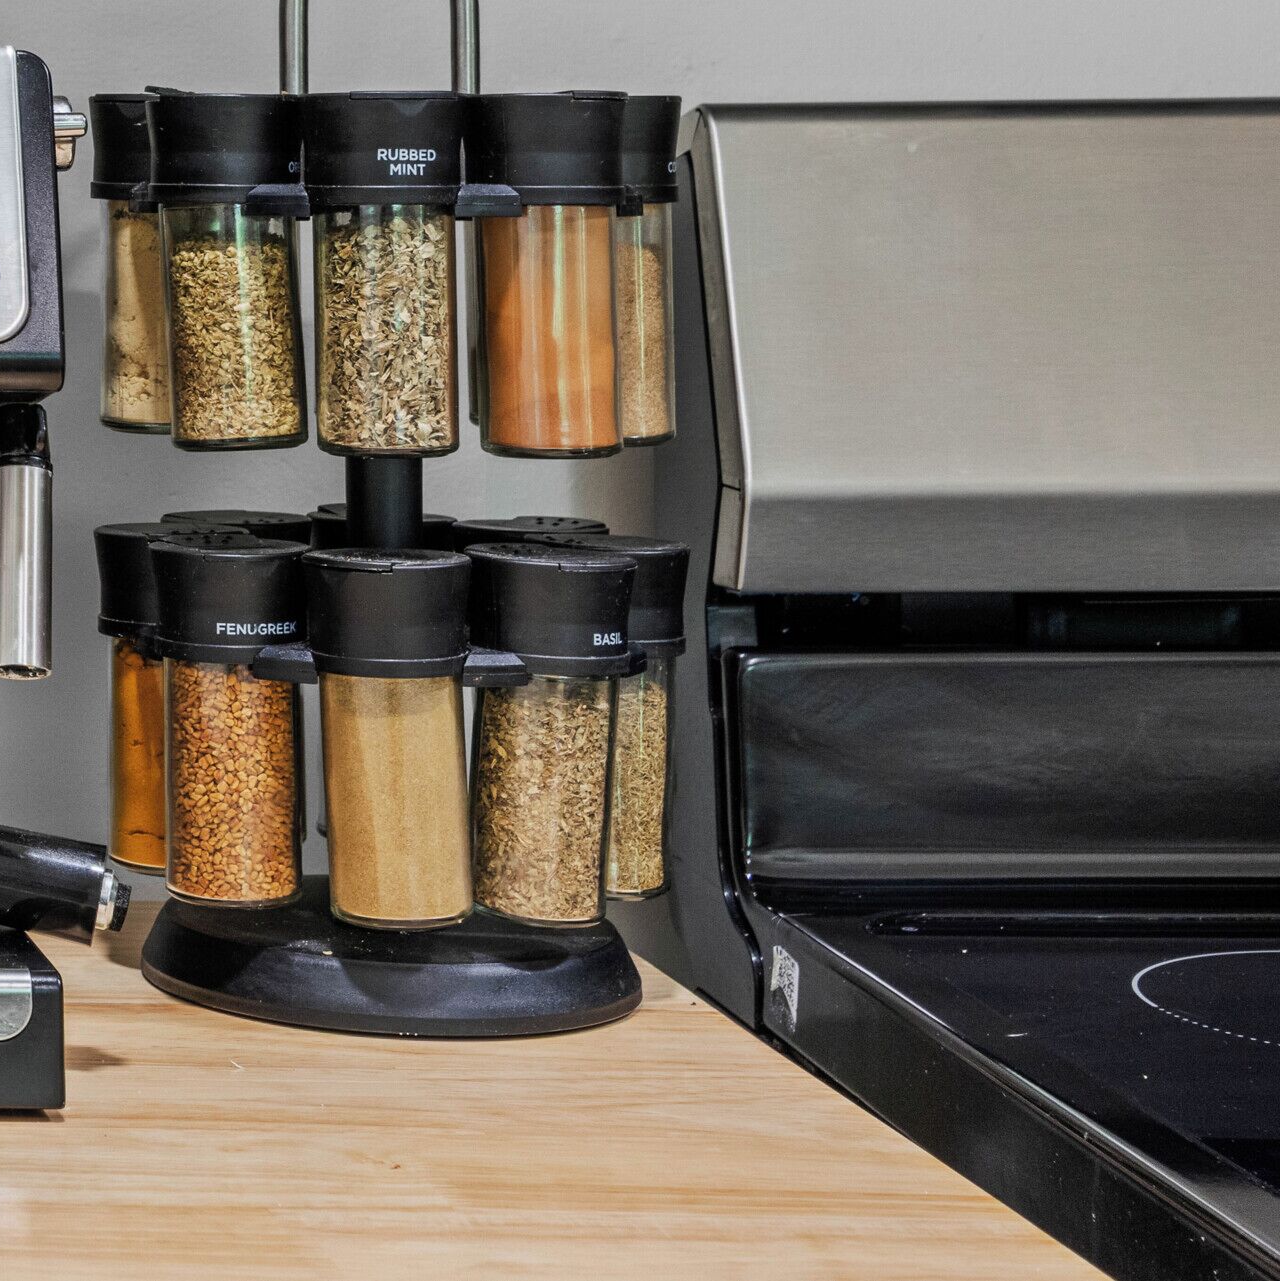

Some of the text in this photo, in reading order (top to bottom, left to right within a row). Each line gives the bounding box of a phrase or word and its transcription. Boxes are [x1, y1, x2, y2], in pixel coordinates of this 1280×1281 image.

[377, 148, 437, 162] RUBBED
[390, 163, 426, 176] MINT
[216, 621, 297, 635] FENUGREEK
[593, 631, 623, 646] BASIL
